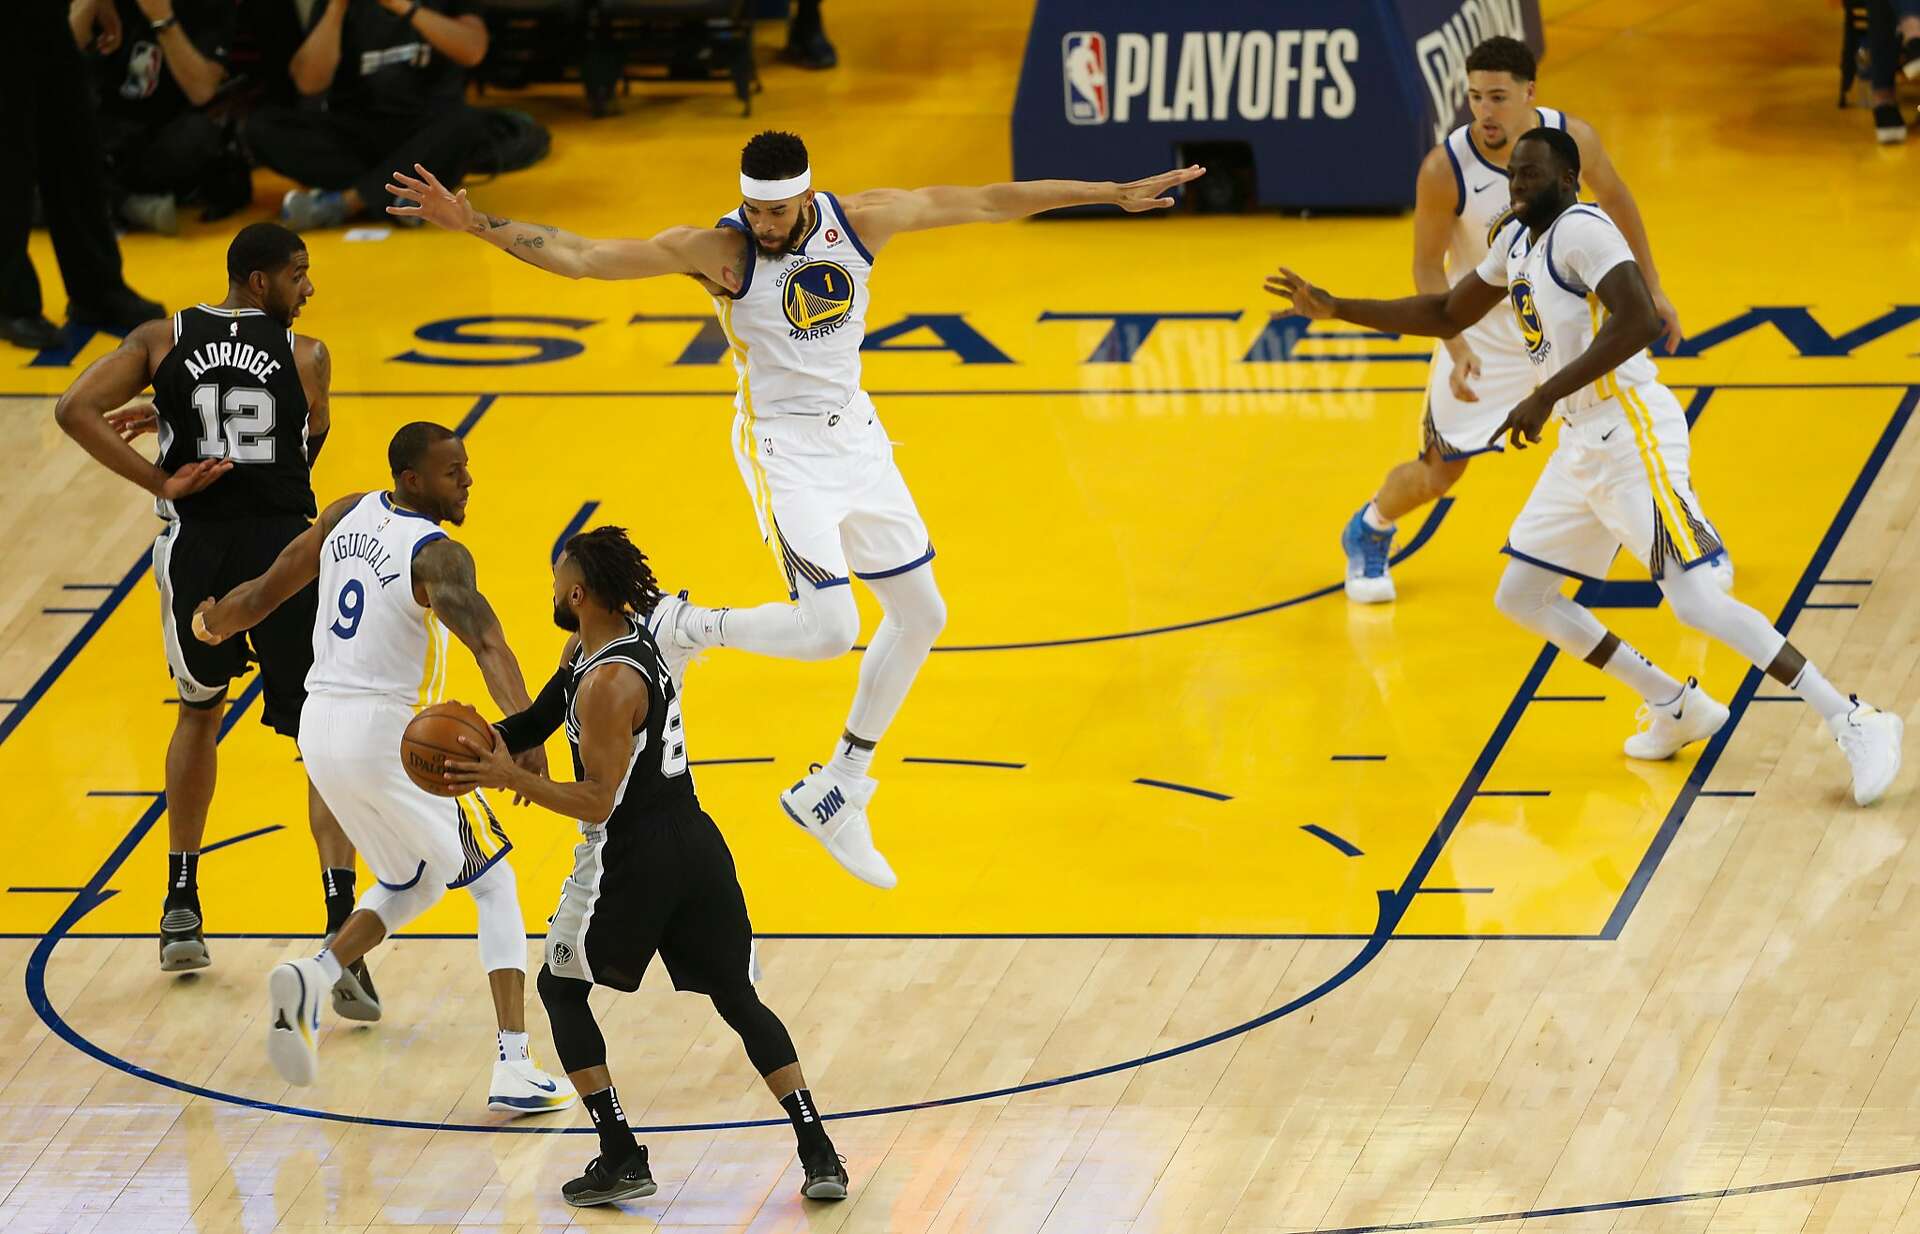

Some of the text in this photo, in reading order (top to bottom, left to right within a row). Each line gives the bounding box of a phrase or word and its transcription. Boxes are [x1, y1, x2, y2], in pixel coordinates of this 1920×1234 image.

[1112, 28, 1360, 123] PLAYOFFS
[824, 272, 834, 294] 1
[184, 342, 281, 384] ALDRIDGE
[191, 383, 276, 463] 12
[331, 533, 400, 589] IGUODALA
[330, 579, 364, 639] 9
[410, 751, 449, 778] SPALD
[661, 698, 687, 779] 8
[812, 785, 846, 825] NIKE
